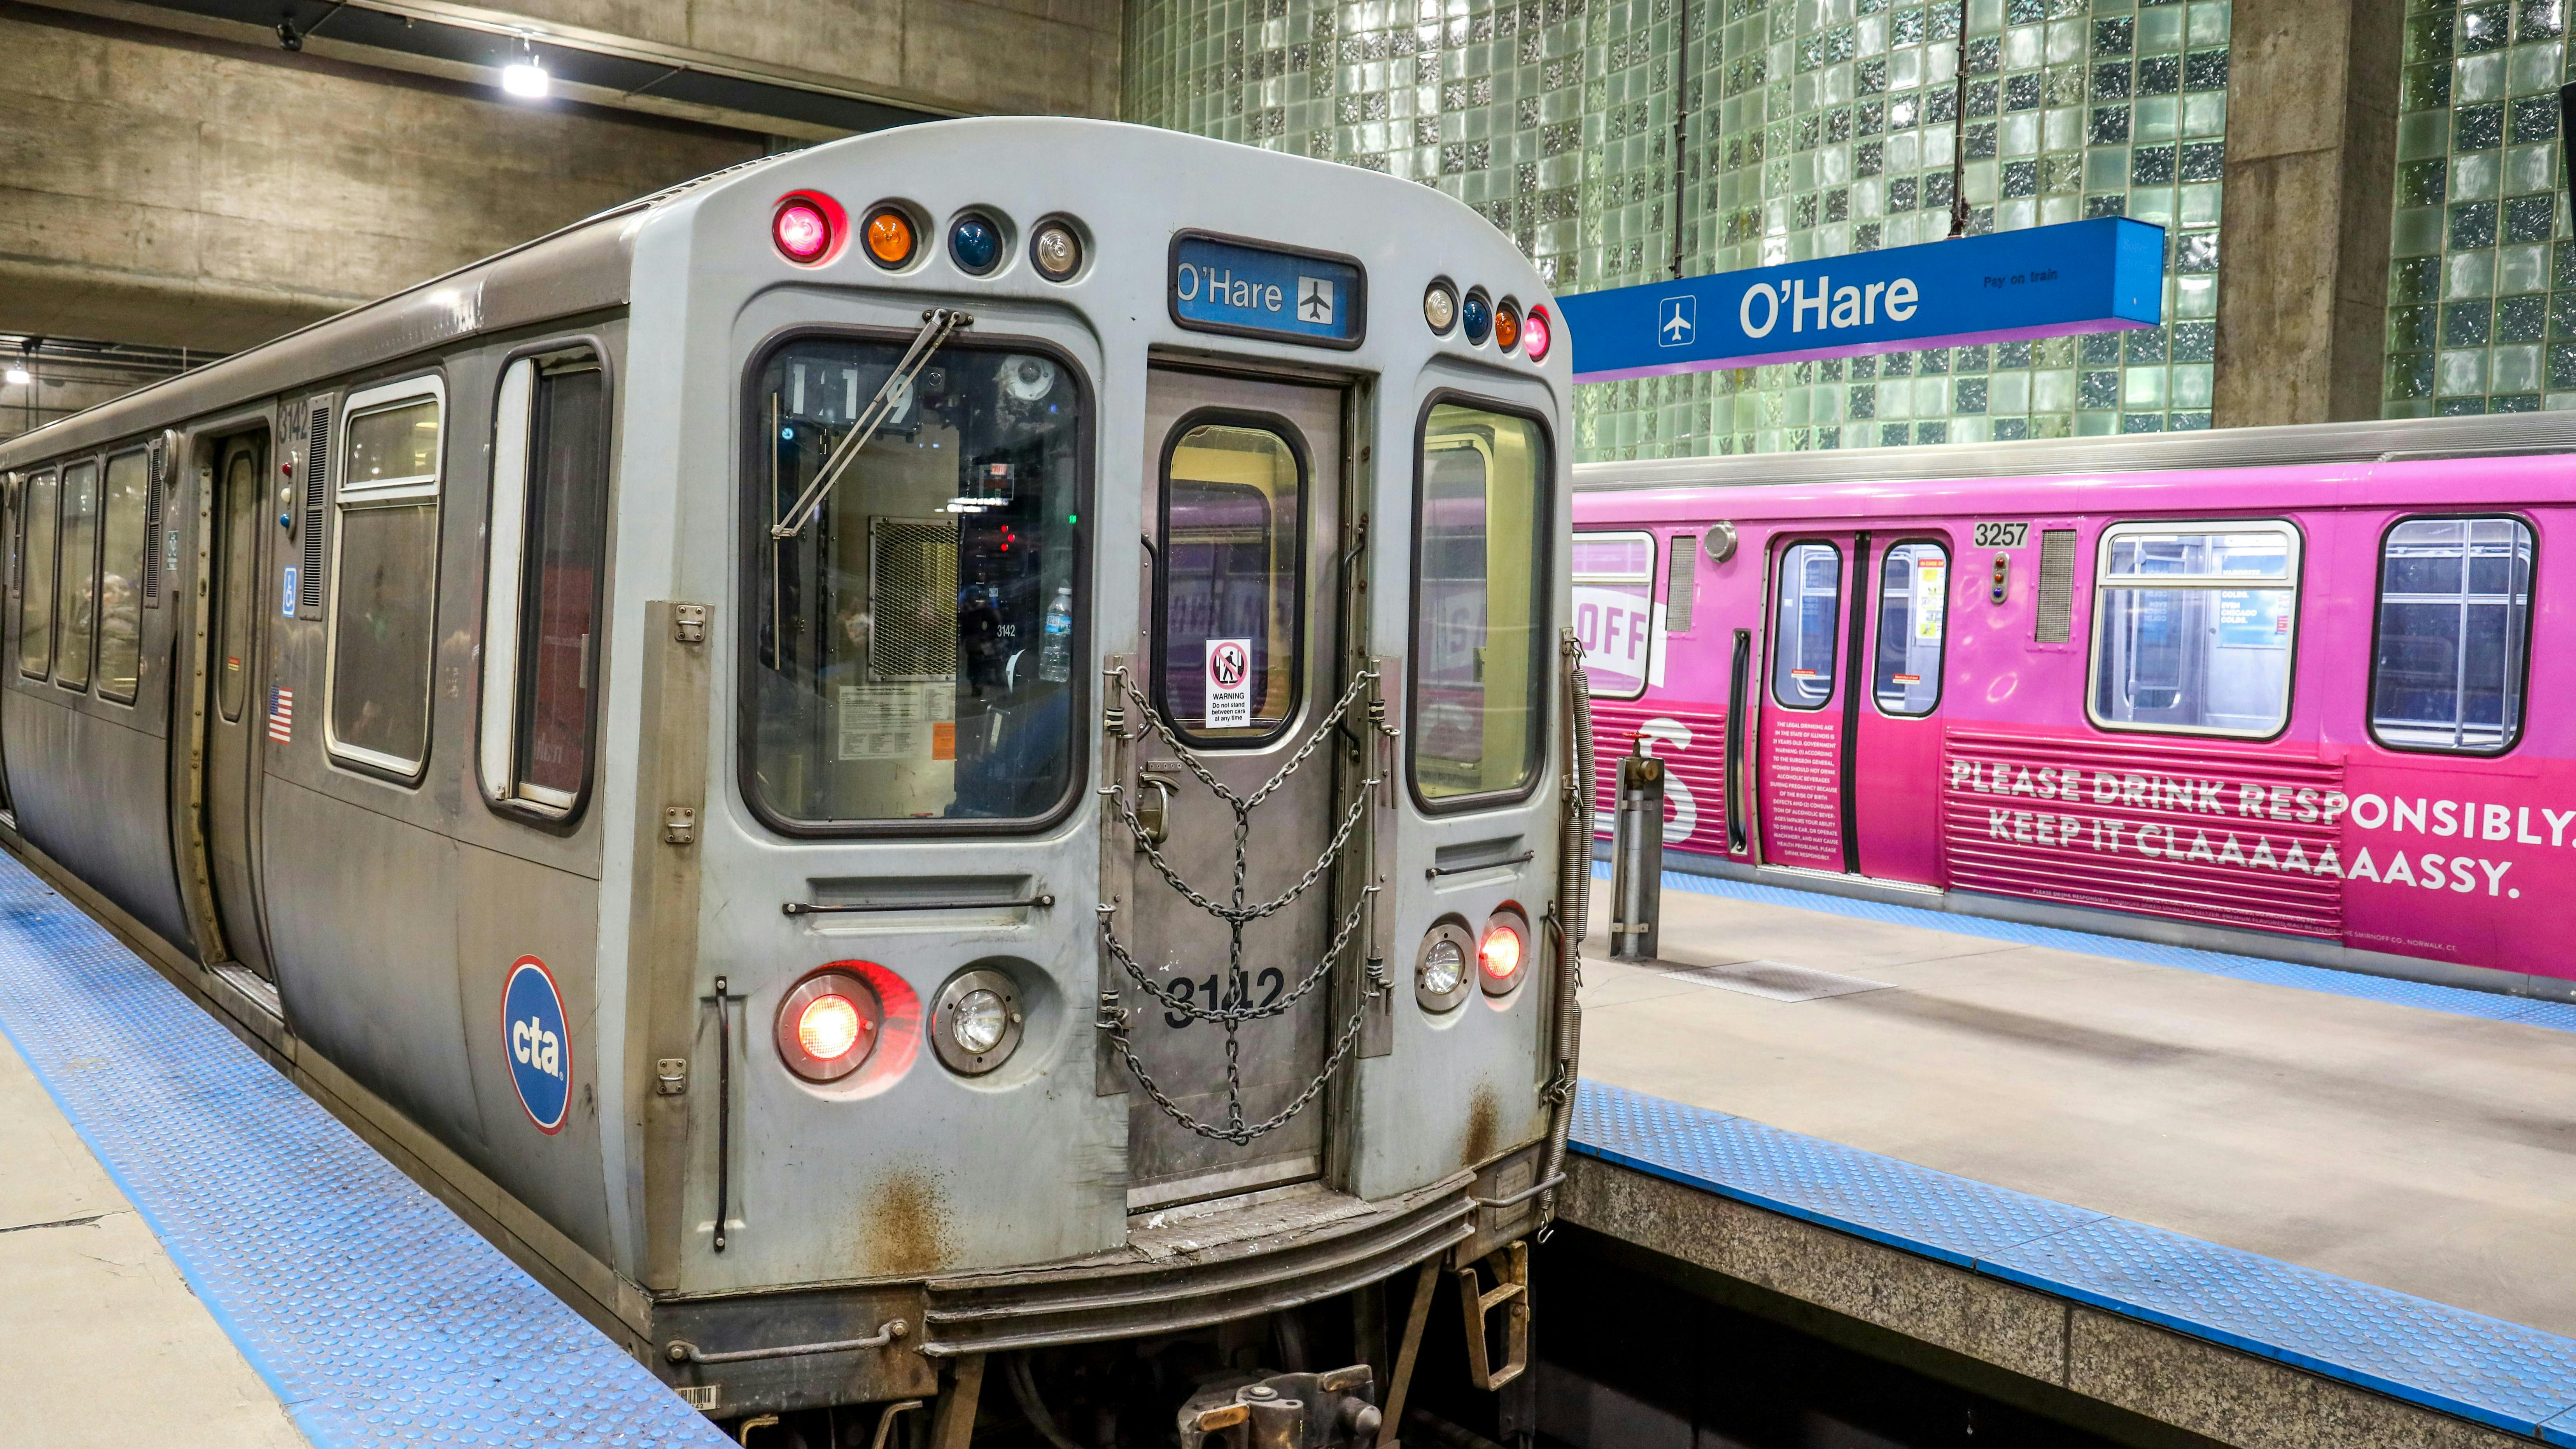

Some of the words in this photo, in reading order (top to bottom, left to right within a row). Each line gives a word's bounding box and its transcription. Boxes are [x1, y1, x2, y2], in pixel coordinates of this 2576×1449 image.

[1178, 262, 1282, 312] O'Hare
[1984, 276, 2005, 289] Pay
[2011, 274, 2025, 284] on
[2030, 268, 2058, 282] train
[1740, 276, 1919, 338] O'Hare
[278, 400, 308, 443] 3142
[1975, 523, 2028, 546] 3257
[997, 624, 1015, 637] 3142
[1576, 603, 1646, 660] OFF
[1951, 759, 2081, 801] PLEASE
[2093, 772, 2225, 815] DRINK
[1989, 808, 2080, 847] KEEP
[2093, 819, 2124, 853] IT
[2136, 824, 2520, 899] CLAAAAAAASSY.
[1164, 967, 1284, 1029] 3142
[513, 1016, 559, 1077] cta
